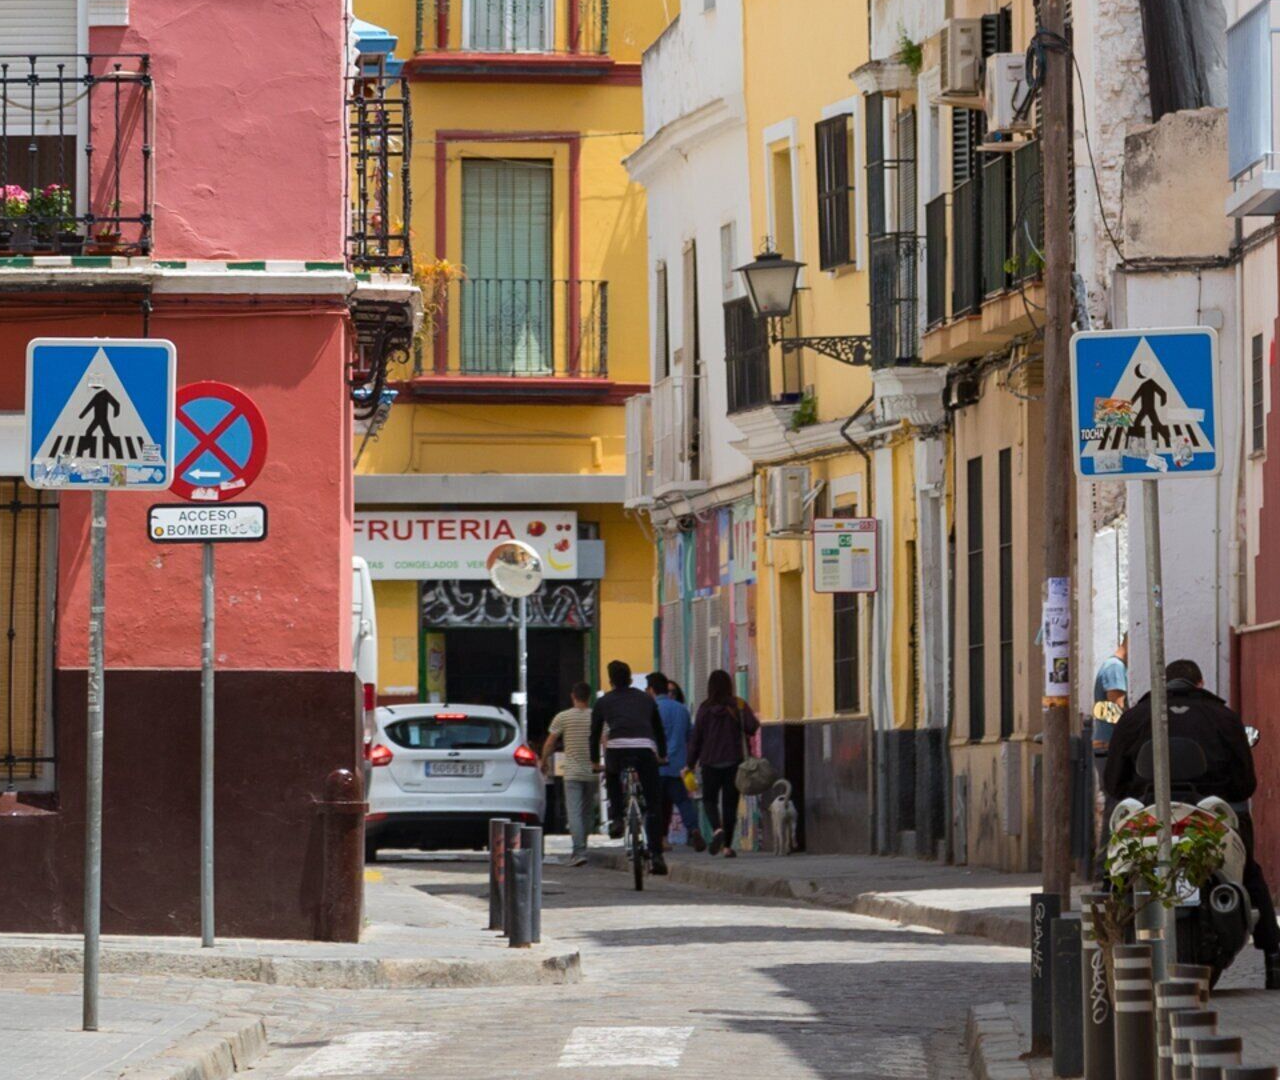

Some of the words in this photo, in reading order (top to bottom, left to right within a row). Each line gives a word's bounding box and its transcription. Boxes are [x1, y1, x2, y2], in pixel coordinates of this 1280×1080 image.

[178, 510, 237, 521] ACCESO
[353, 520, 515, 540] FRUTERIA
[394, 561, 458, 569] CONGELADOS
